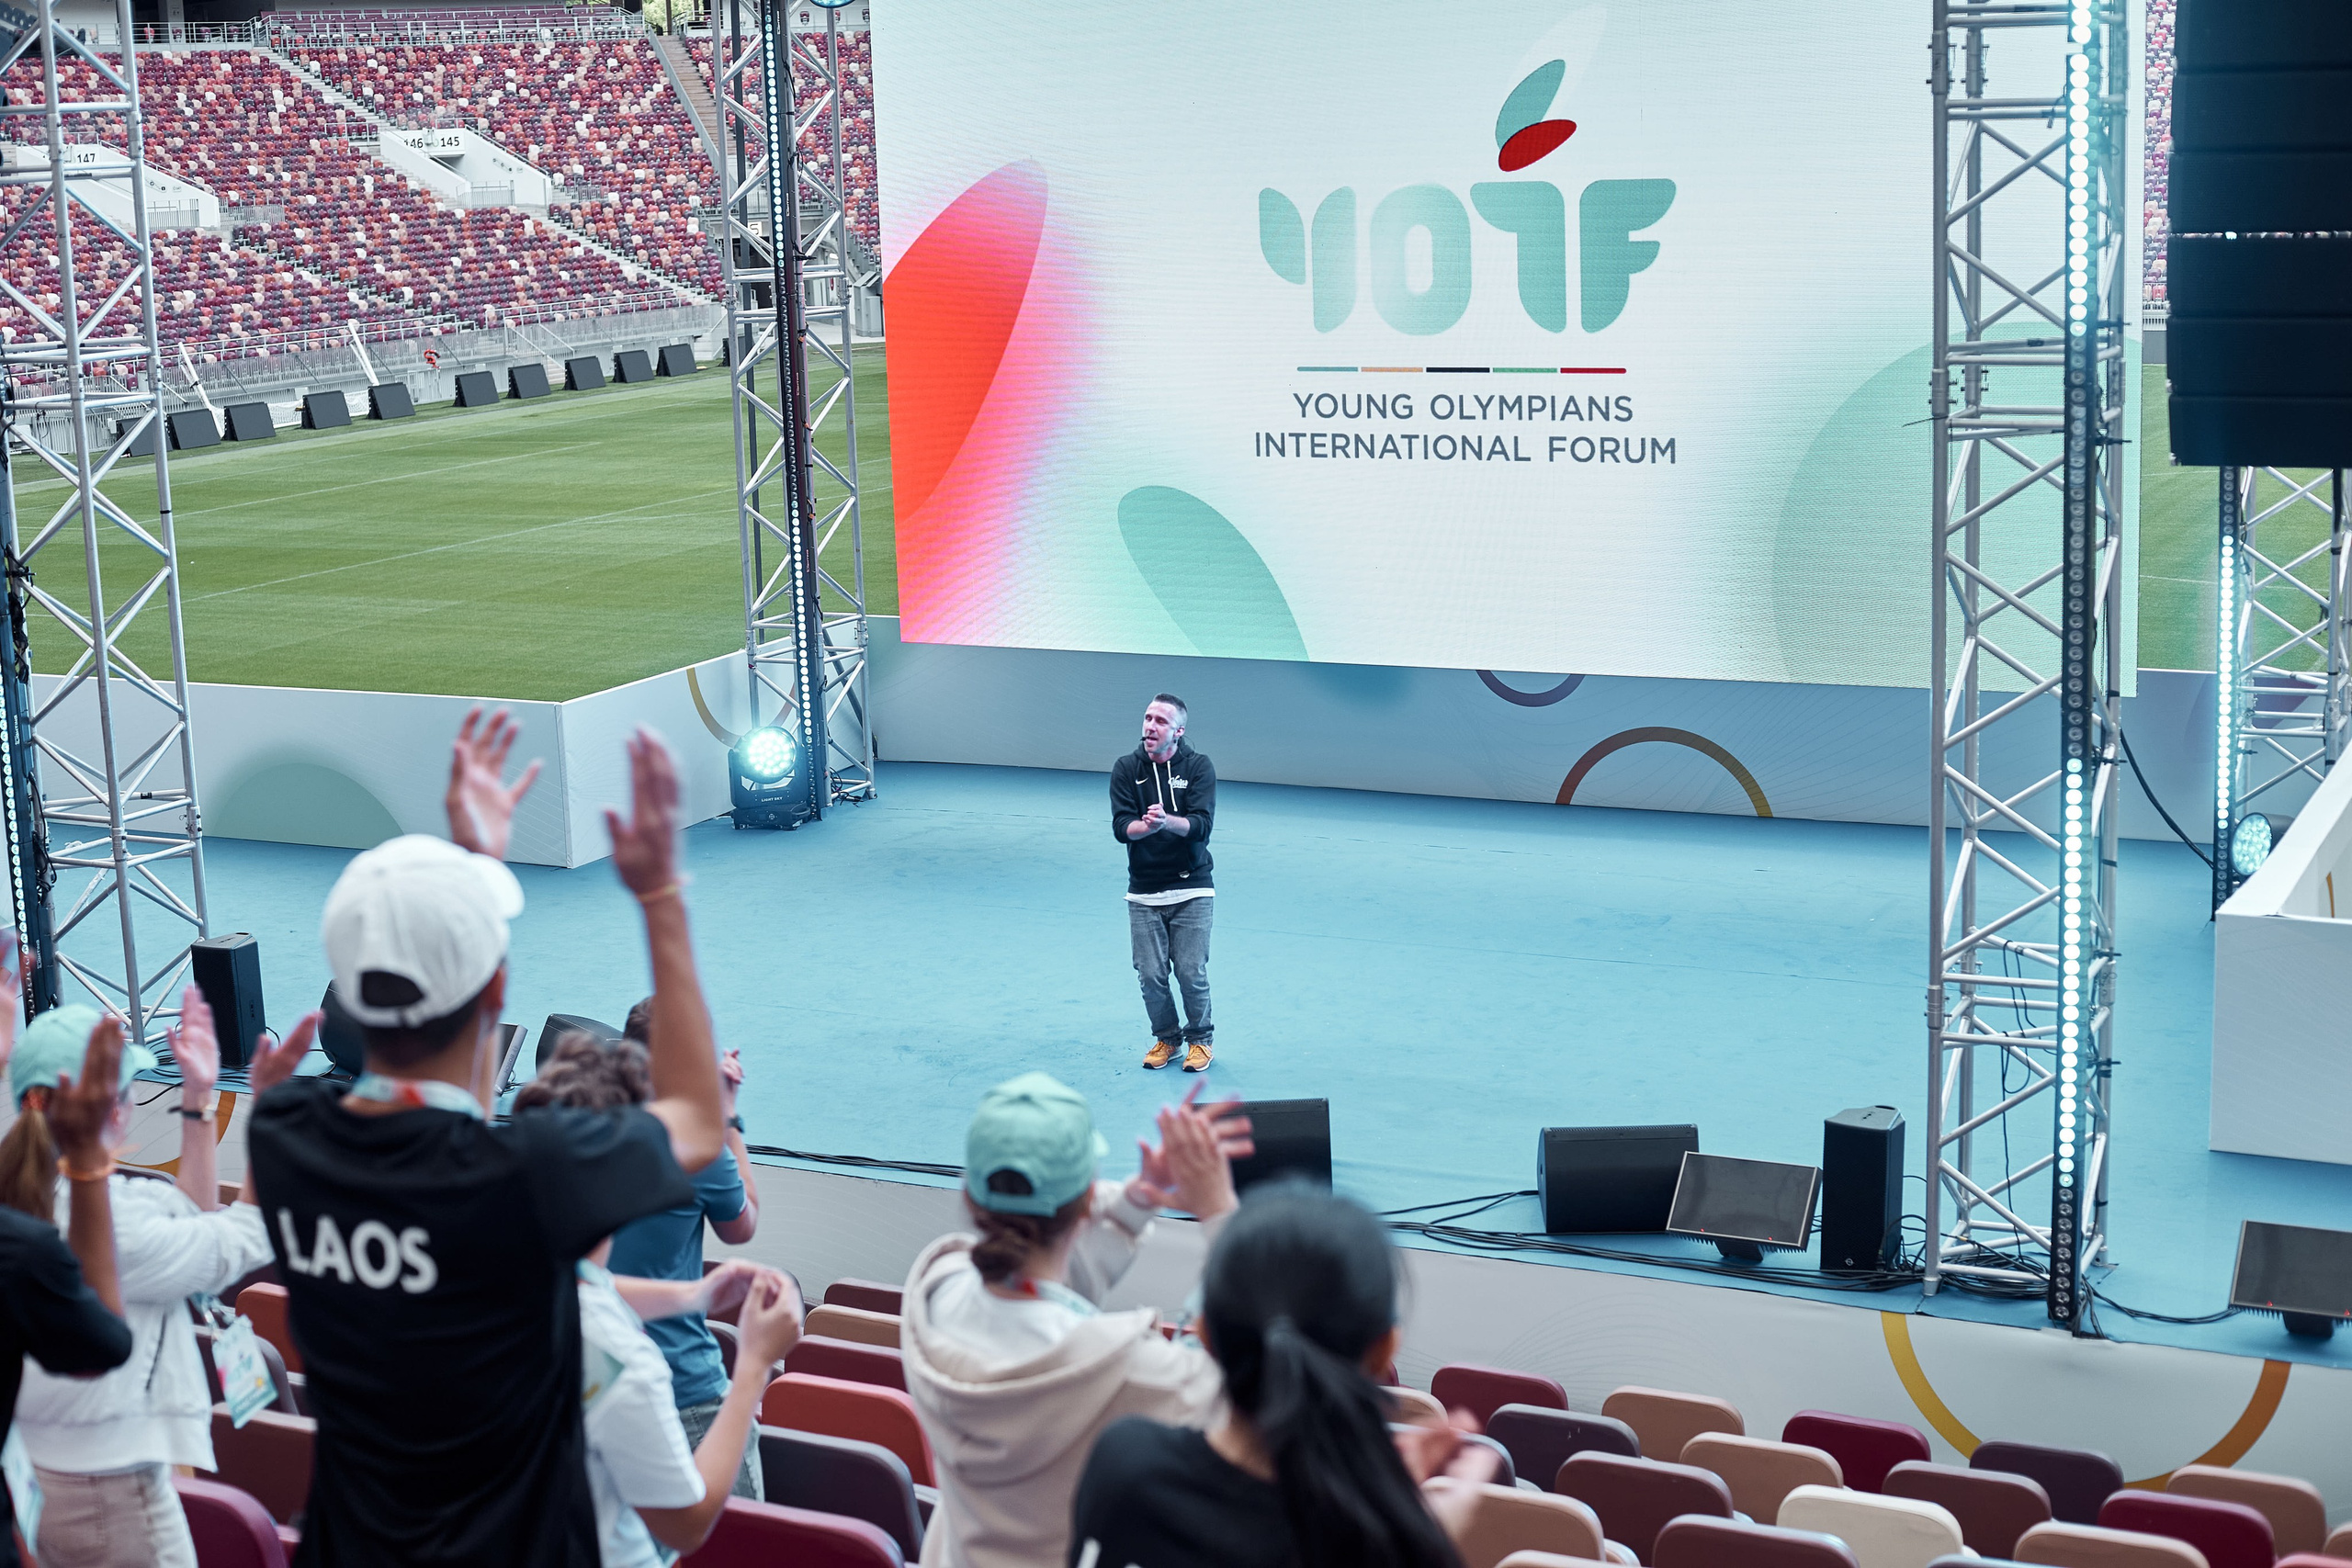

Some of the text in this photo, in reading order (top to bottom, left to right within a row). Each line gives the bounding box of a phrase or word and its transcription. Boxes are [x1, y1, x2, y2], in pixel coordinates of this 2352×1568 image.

[440, 137, 459, 147] 145
[77, 153, 96, 164] 147
[1294, 392, 1634, 423] YOUNG OLYMPIANS
[1255, 432, 1677, 465] INTERNATIONAL FORUM
[277, 1207, 438, 1294] LAOS
